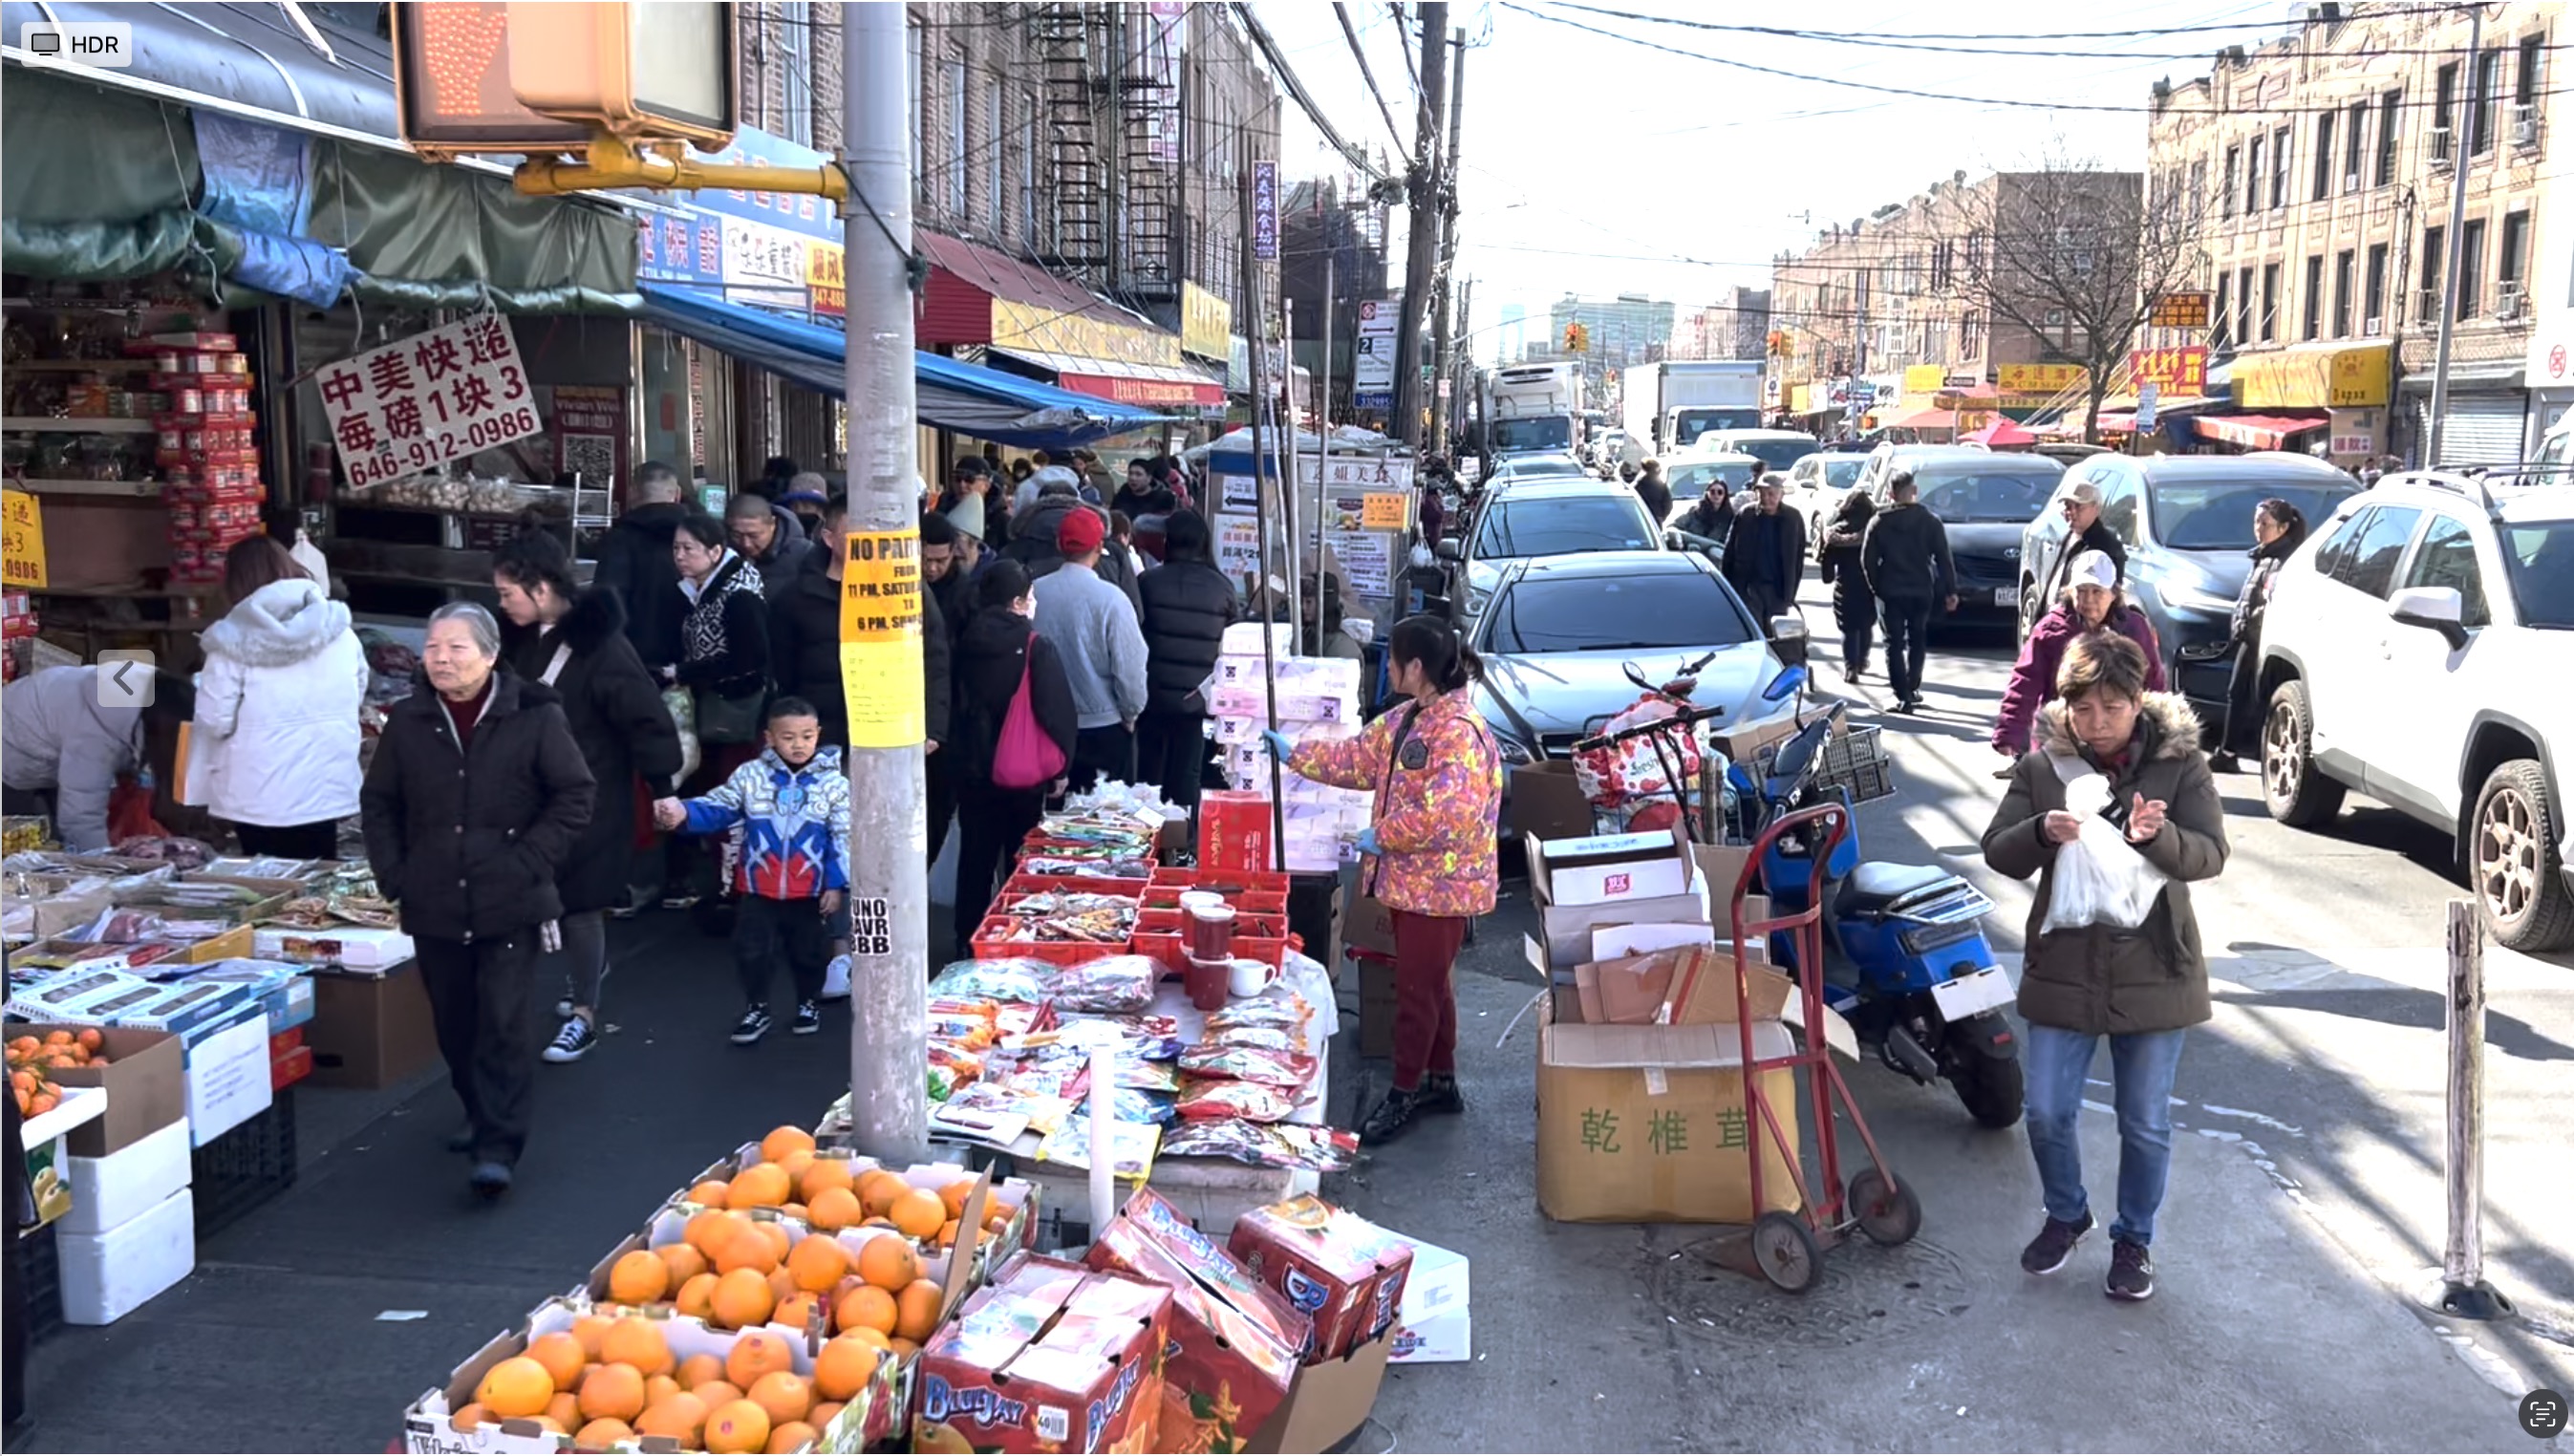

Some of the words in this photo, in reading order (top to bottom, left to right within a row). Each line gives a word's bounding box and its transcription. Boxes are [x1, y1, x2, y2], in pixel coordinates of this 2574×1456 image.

[1361, 338, 1370, 353] 2
[350, 407, 534, 487] 646-912-0986
[850, 537, 873, 561] NO
[847, 584, 857, 598] 11
[903, 599, 914, 610] TO
[857, 617, 866, 631] 6
[852, 898, 887, 917] UNO
